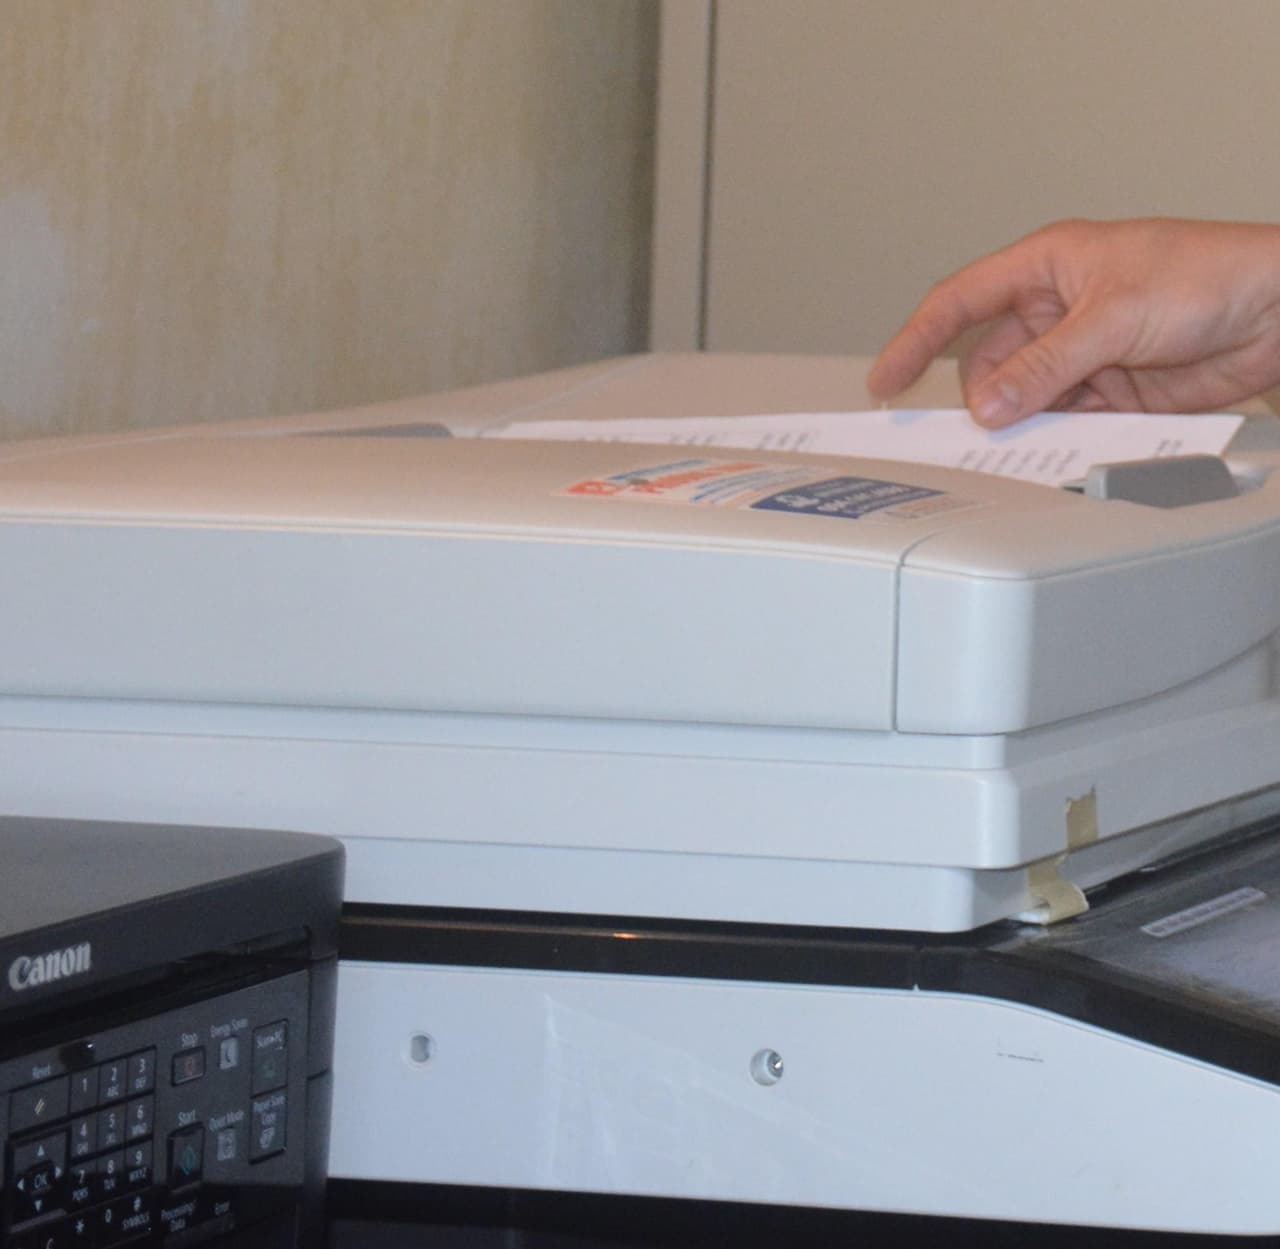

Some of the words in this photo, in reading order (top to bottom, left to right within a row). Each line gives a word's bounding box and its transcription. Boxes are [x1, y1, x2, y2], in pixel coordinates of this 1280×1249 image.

[8, 941, 92, 992] Canon
[138, 1057, 146, 1073] 3
[110, 1066, 118, 1082] 2
[81, 1077, 88, 1093] 1
[136, 1103, 145, 1120] 6
[178, 1109, 196, 1126] Start
[108, 1112, 116, 1129] 5
[80, 1122, 88, 1138] 4
[107, 1158, 115, 1175] 8
[135, 1150, 143, 1166] 9
[33, 1171, 49, 1189] OK
[78, 1168, 86, 1185] 7
[104, 1207, 113, 1224] 0
